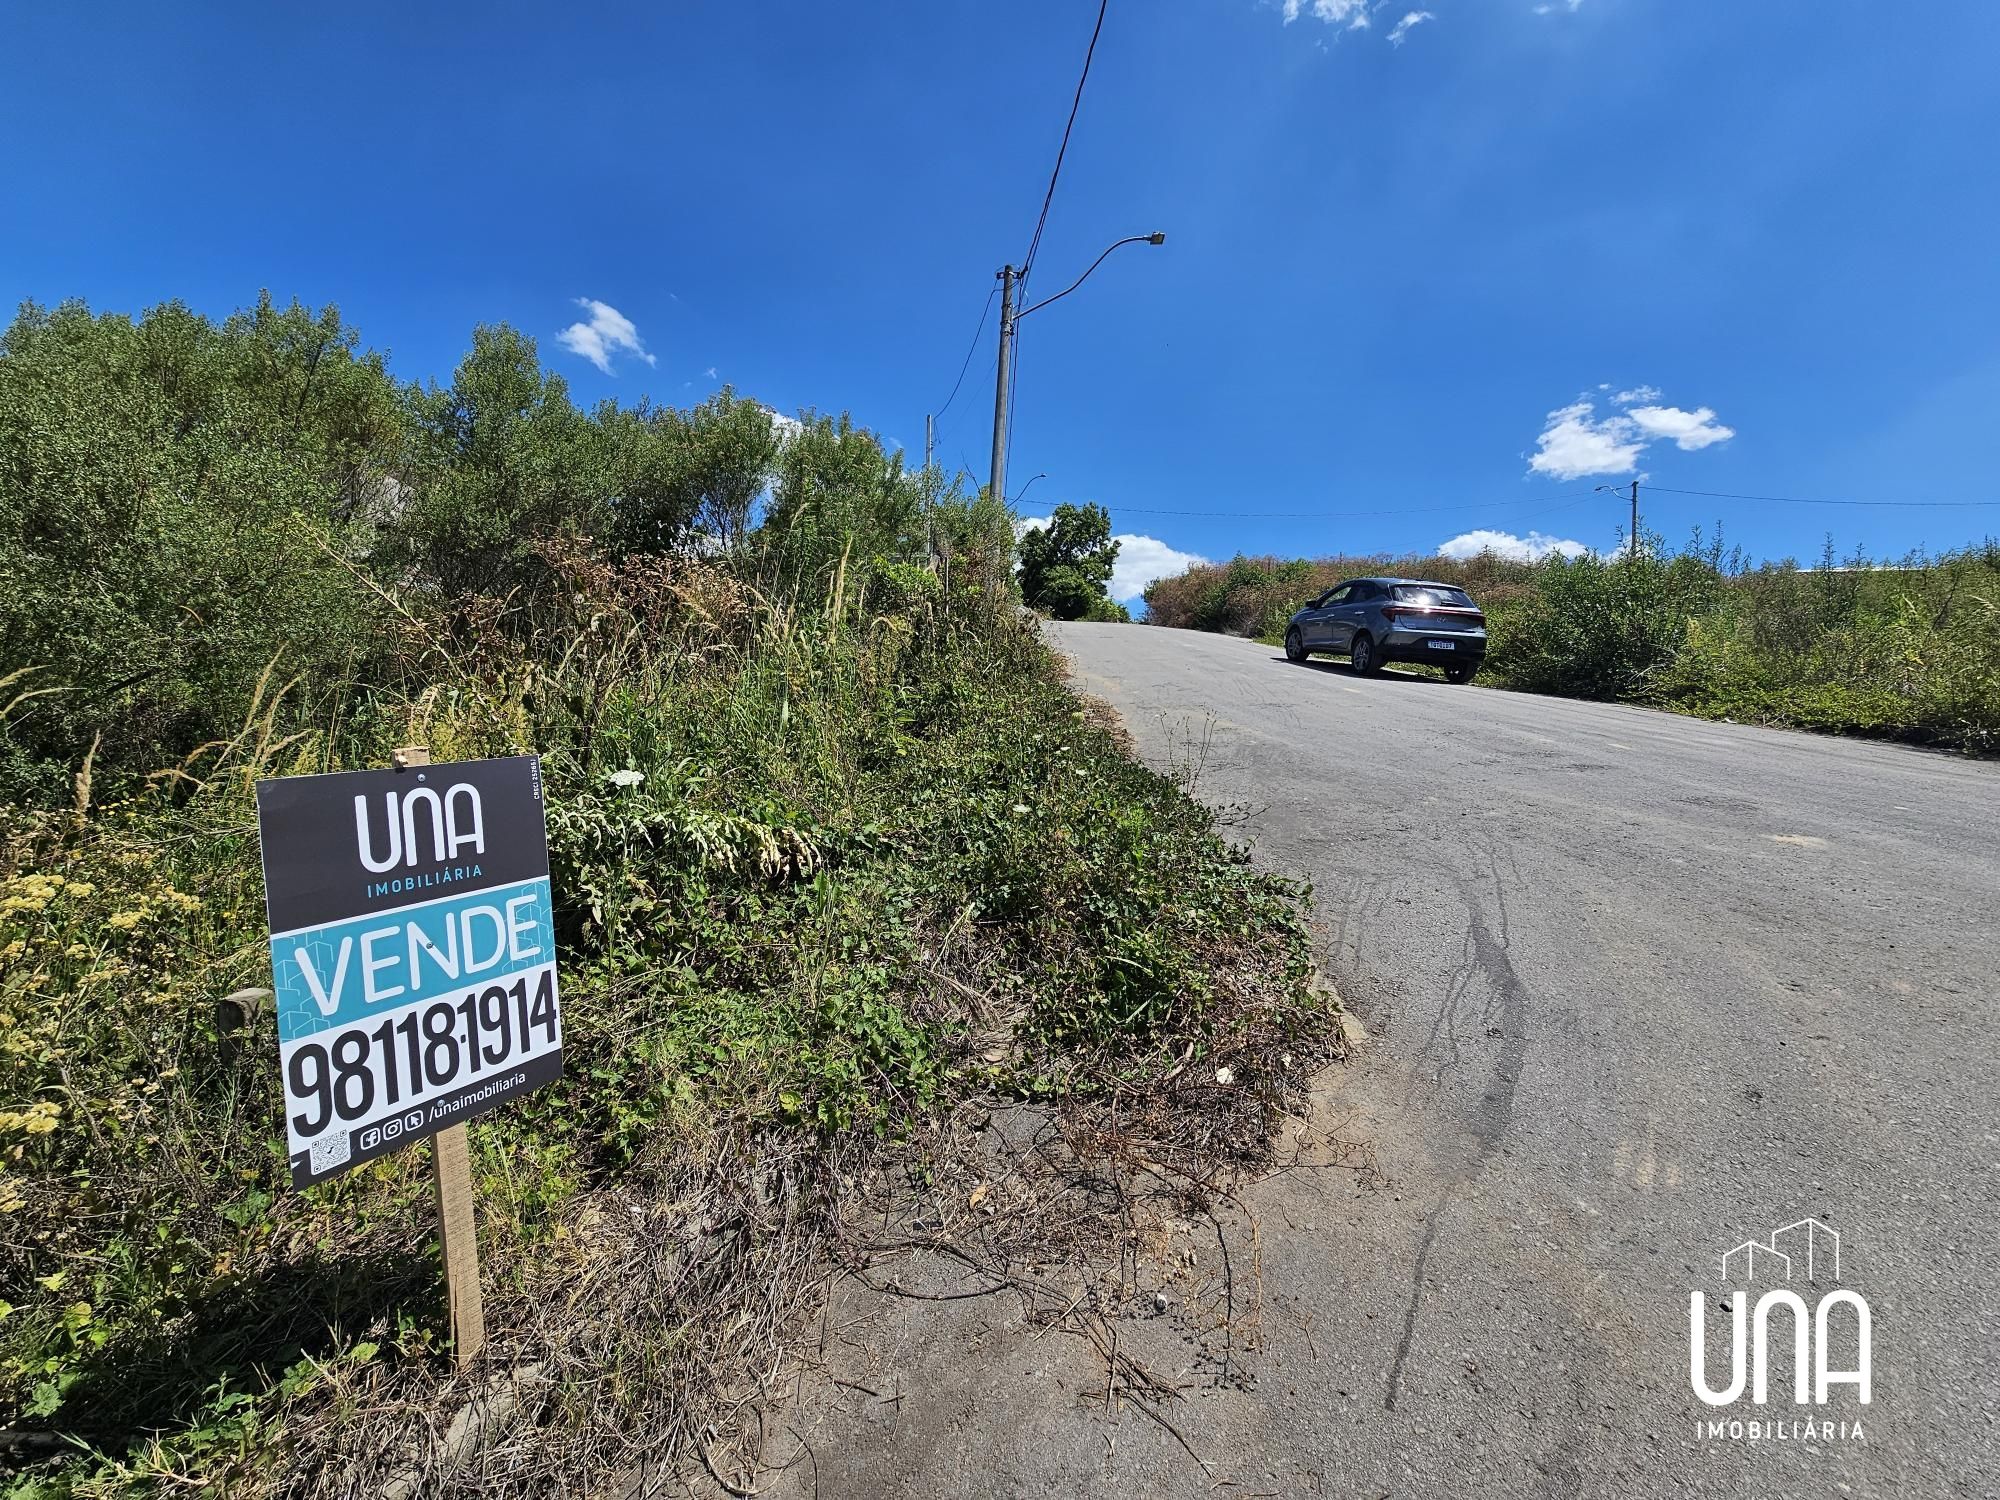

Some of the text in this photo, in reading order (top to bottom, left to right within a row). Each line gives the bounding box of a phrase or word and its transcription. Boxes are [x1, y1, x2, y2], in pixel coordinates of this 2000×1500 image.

[354, 782, 486, 874] UNA
[367, 864, 483, 898] IMOBILIÁRIA
[294, 893, 542, 1017] VENDE
